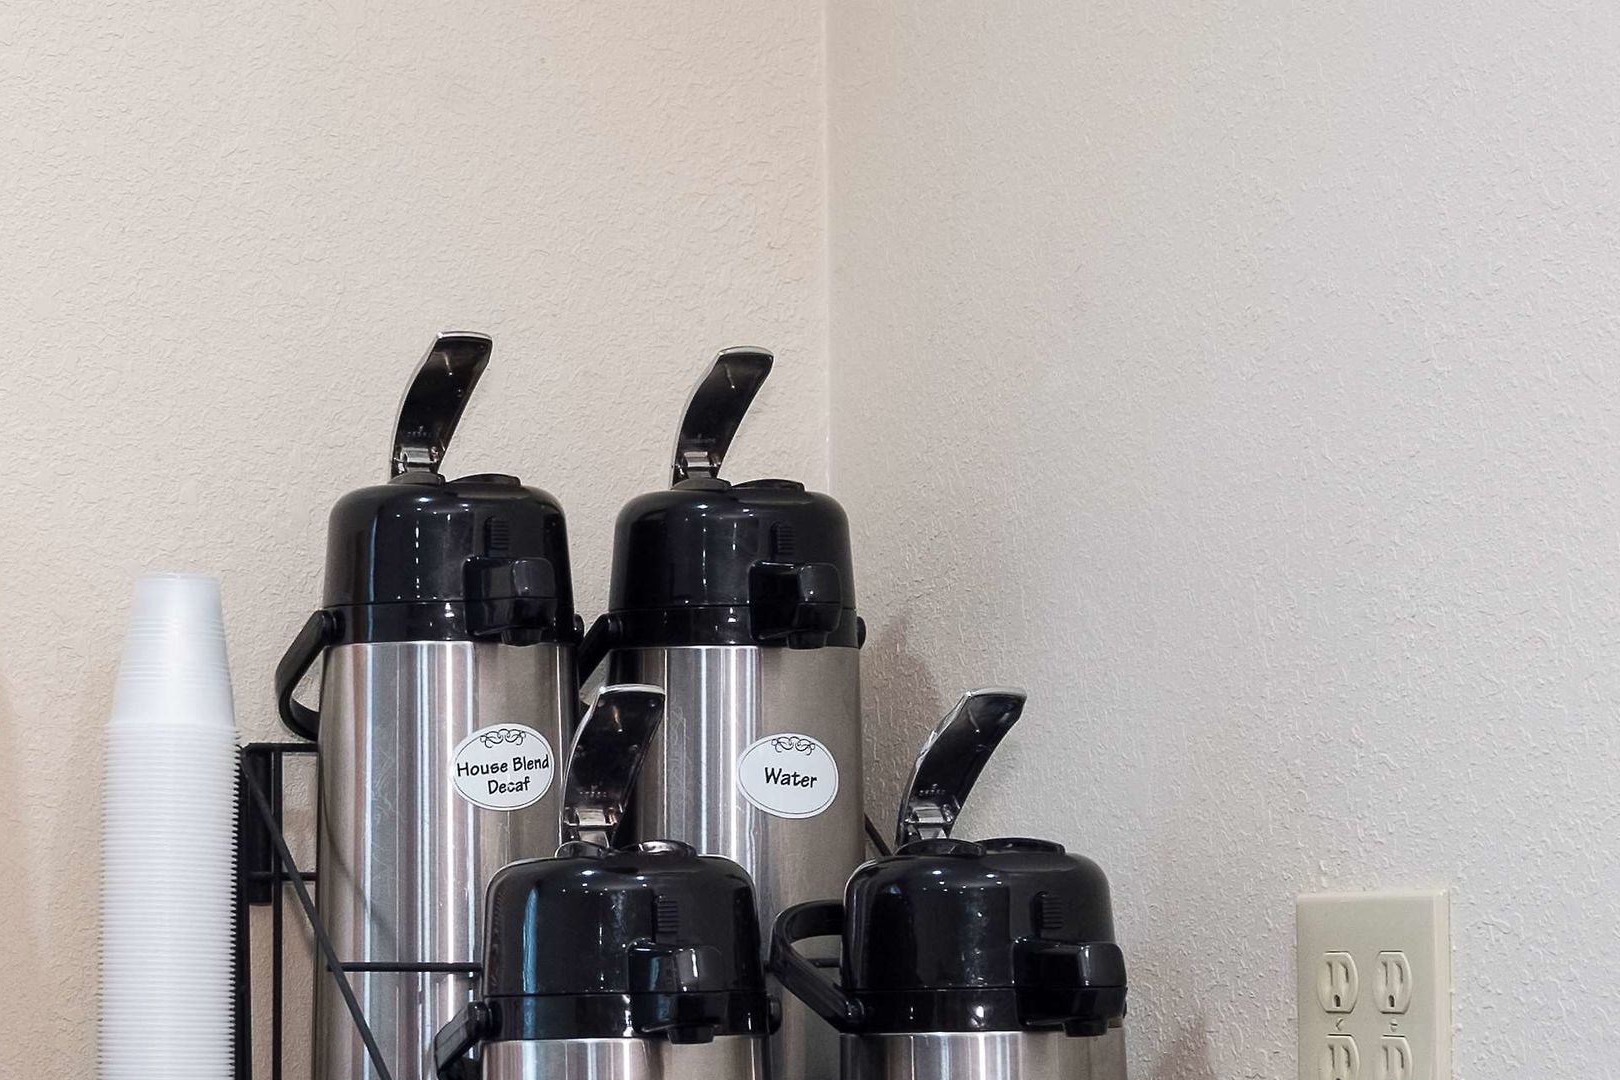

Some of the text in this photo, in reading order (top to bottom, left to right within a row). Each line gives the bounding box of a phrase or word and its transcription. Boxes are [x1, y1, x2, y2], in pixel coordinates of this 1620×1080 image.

[456, 753, 551, 777] House Blend
[487, 775, 531, 795] Decaf
[764, 766, 818, 789] Water
